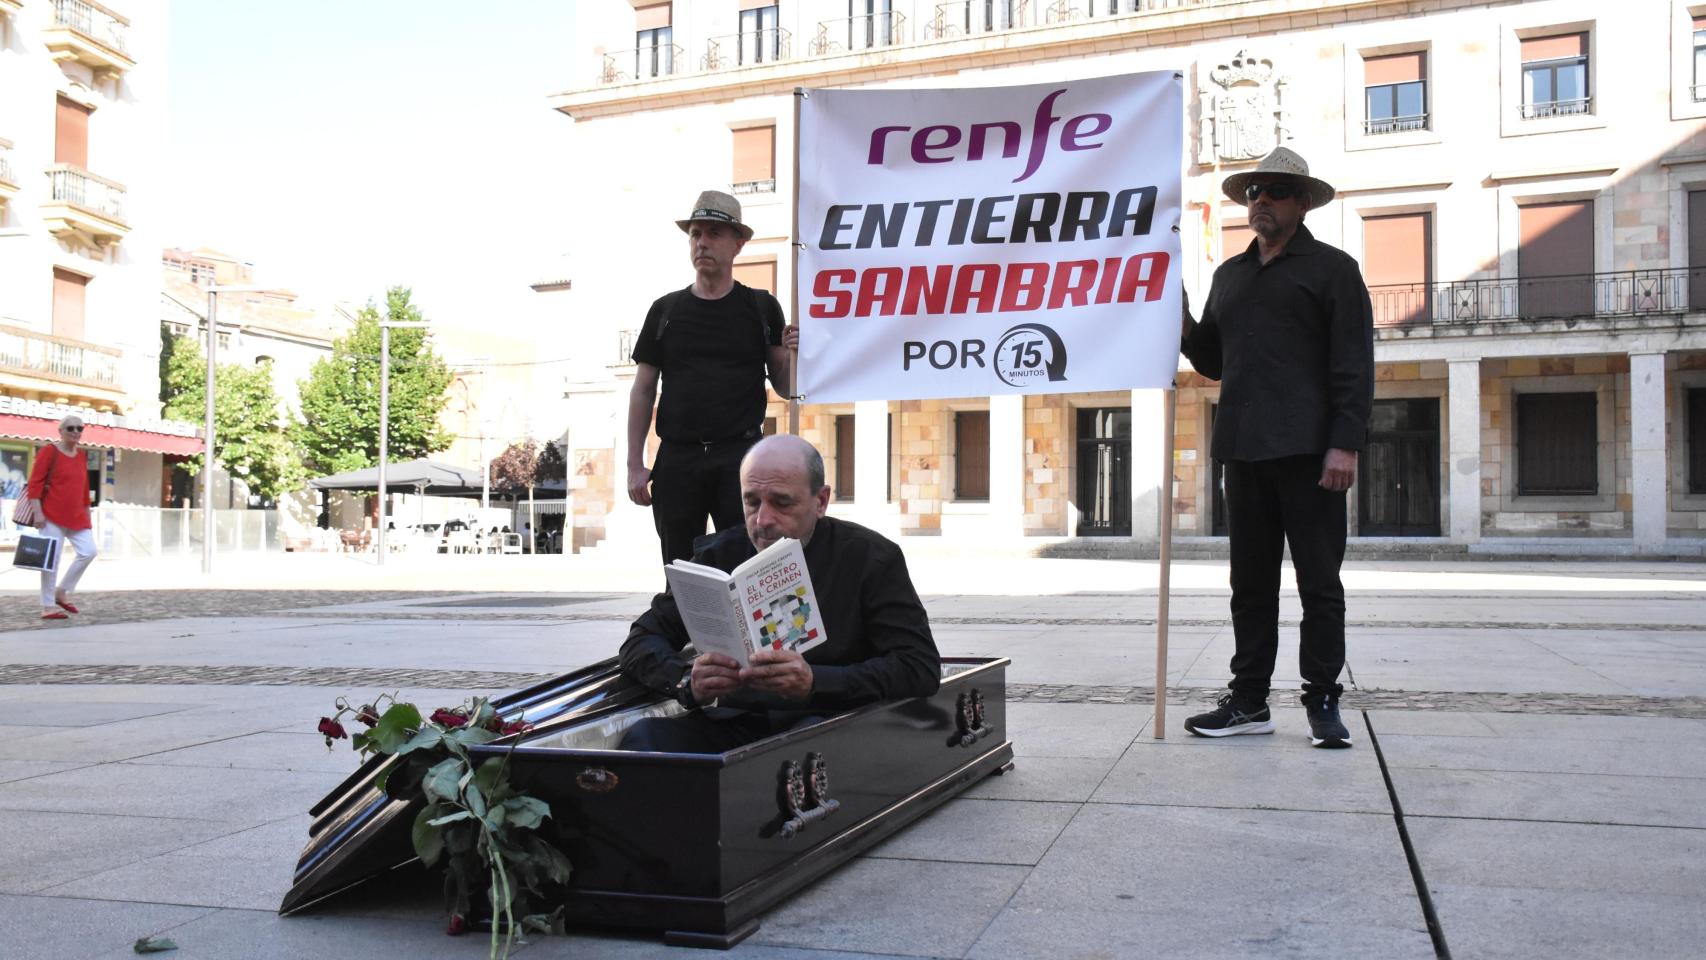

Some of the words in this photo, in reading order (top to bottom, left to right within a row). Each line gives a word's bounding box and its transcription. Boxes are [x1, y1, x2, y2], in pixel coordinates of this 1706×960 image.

[867, 88, 1112, 183] renfe
[818, 185, 1158, 251] ENTIERRA
[809, 251, 1170, 319] SANABRIA
[903, 339, 986, 372] POR
[1011, 340, 1044, 369] 15
[1009, 369, 1045, 378] MINUTOS
[747, 584, 756, 595] EL
[759, 562, 798, 588] ROSTRO
[747, 591, 764, 605] DEL
[766, 570, 802, 593] CRIMEN
